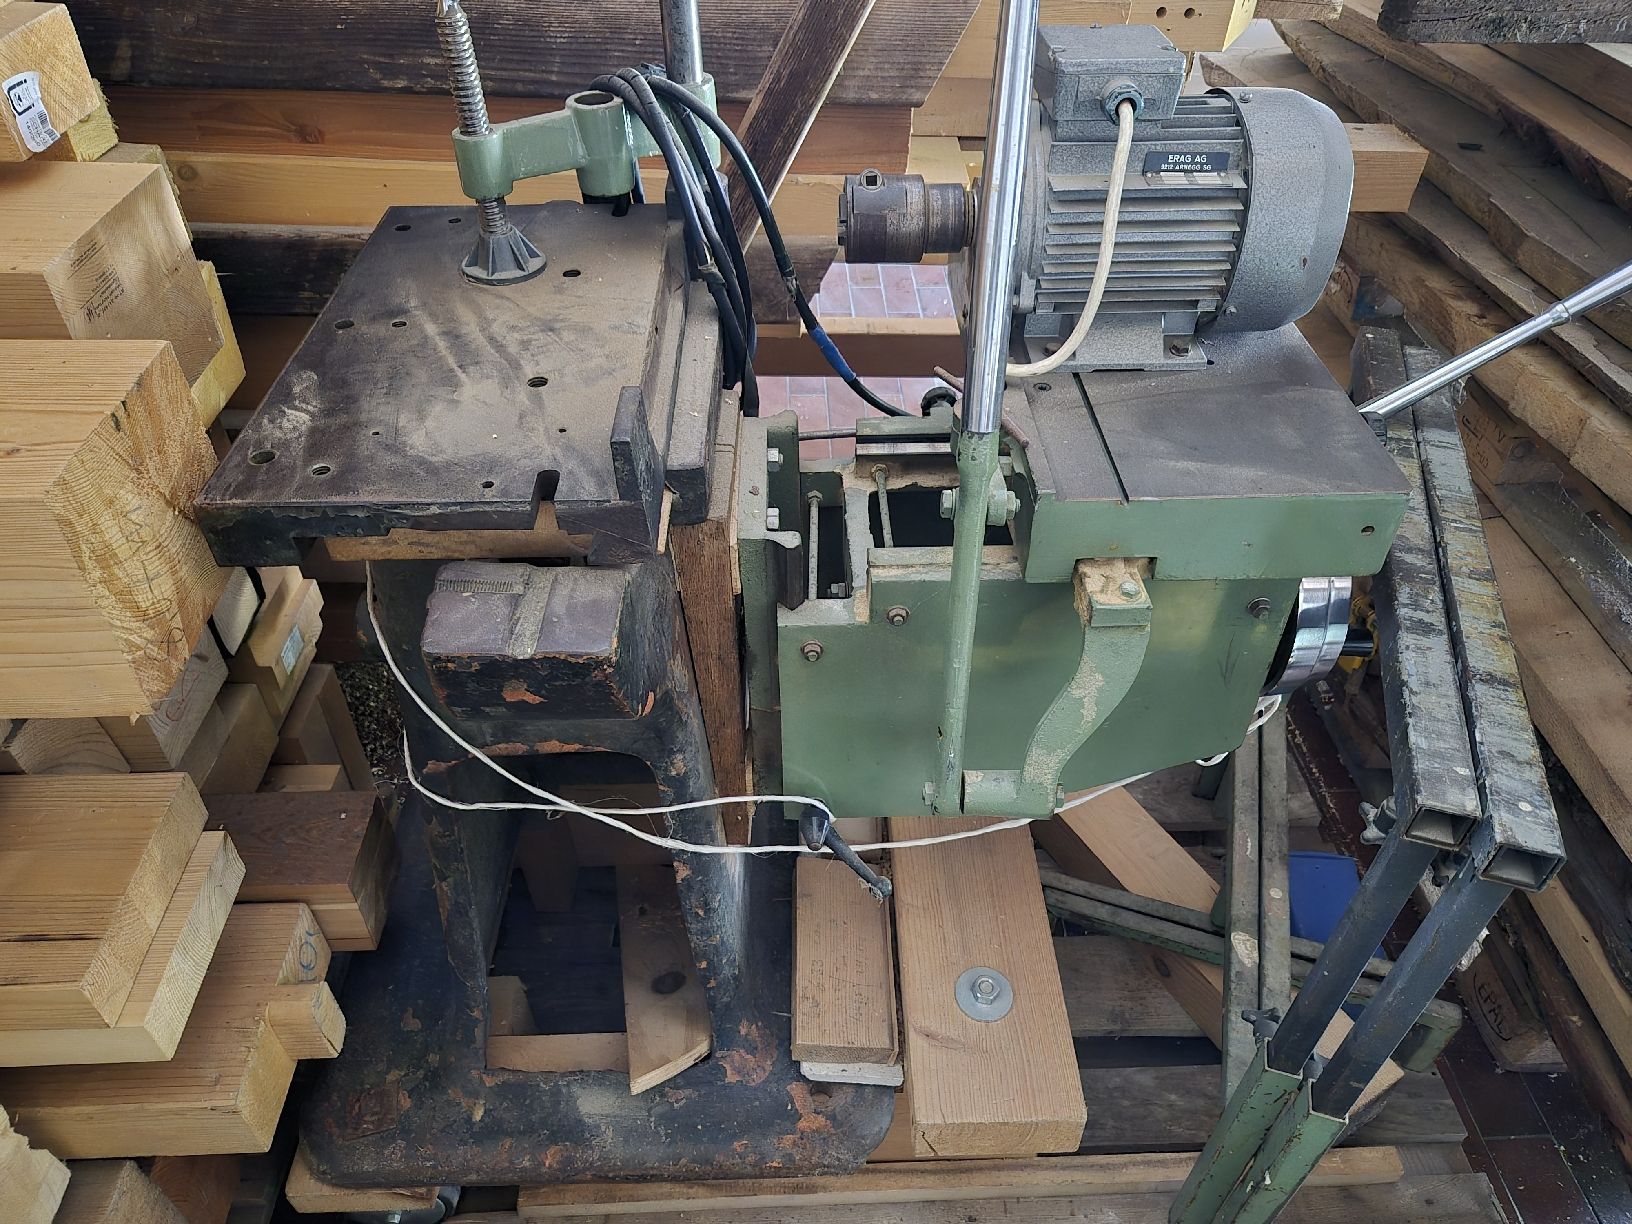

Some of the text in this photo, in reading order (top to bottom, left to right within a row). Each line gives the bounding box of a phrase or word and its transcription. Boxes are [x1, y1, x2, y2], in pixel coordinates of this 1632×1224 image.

[1168, 154, 1207, 163] ERAG AG
[1478, 983, 1504, 1034] EPAL
